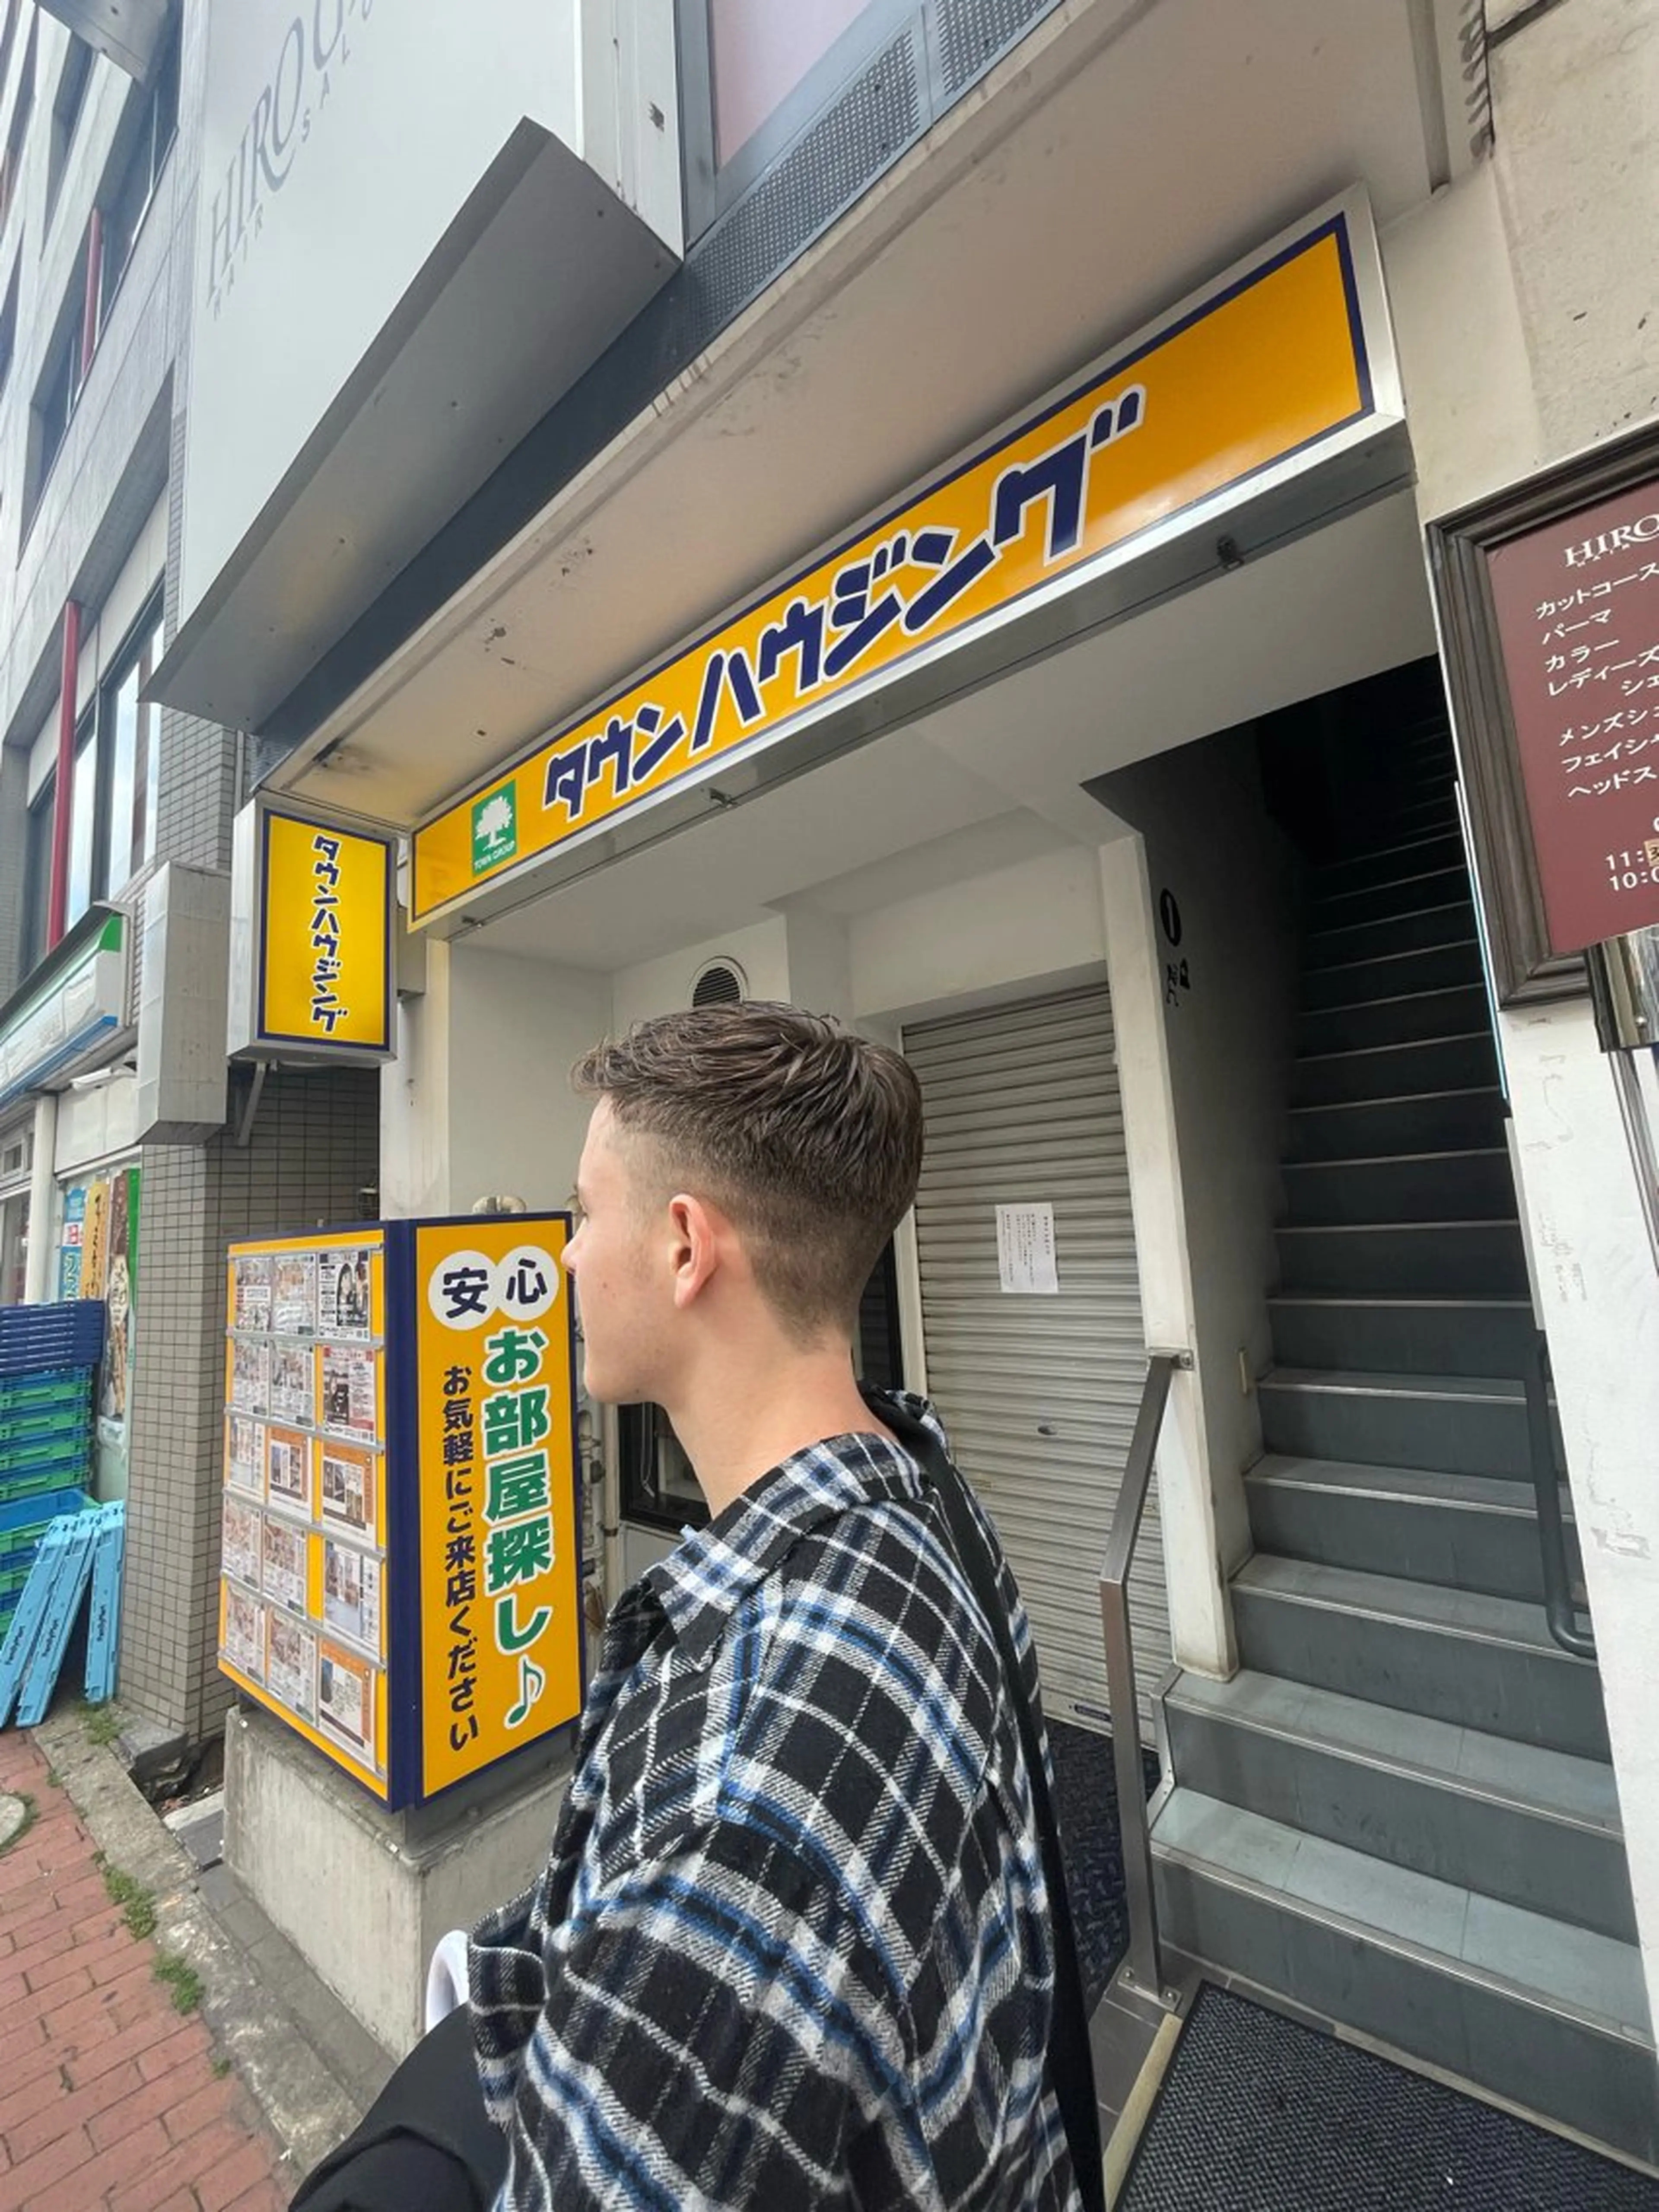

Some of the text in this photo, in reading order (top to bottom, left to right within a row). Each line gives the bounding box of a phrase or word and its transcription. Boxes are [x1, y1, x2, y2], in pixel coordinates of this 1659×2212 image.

[543, 384, 1146, 822] タウンハウジング
[1536, 562, 1659, 620] カットコース
[1542, 609, 1611, 645] パーマ
[1545, 639, 1619, 673] カラー
[1568, 766, 1657, 798] ヘッドス
[311, 834, 348, 1033] タウンハウジング
[442, 1258, 548, 1319] 安心
[442, 1366, 478, 1751] お気軽にご来店ください
